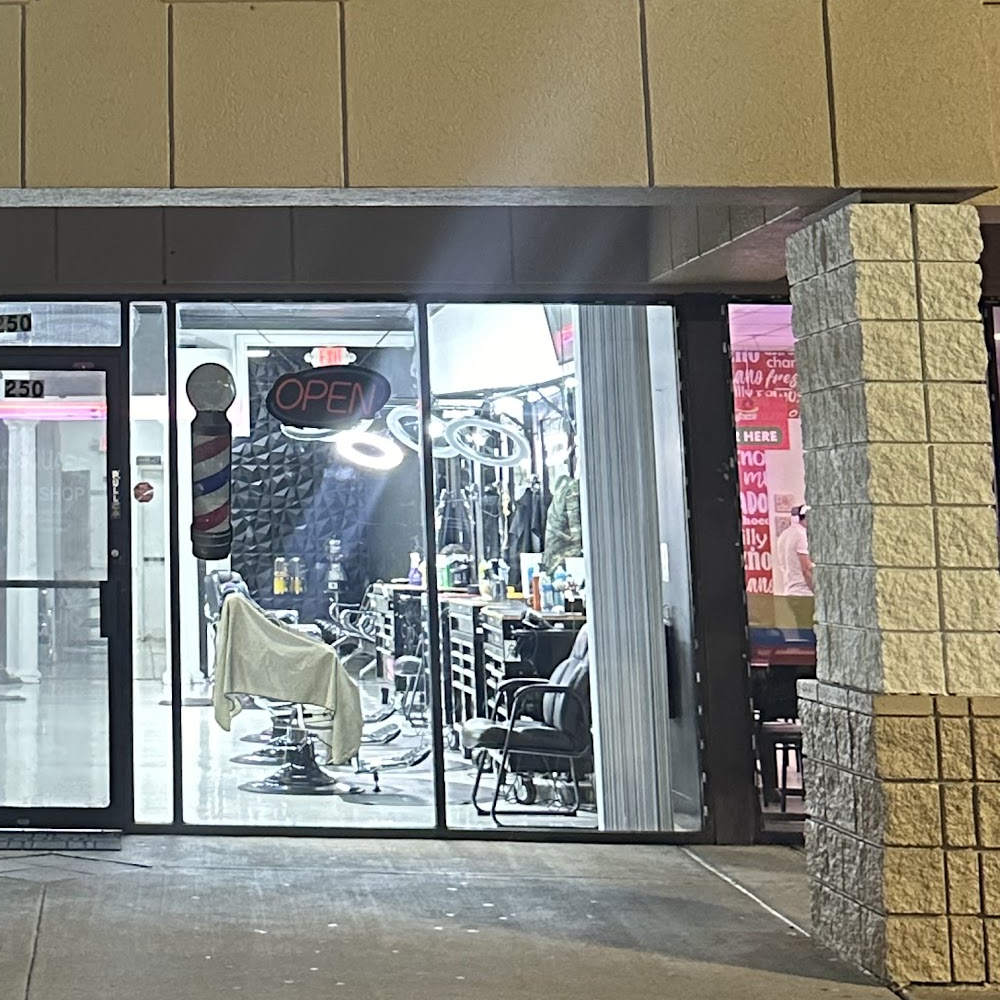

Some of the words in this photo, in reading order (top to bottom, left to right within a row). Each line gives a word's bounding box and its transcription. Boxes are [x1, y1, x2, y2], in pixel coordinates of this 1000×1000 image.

[6, 380, 44, 397] 250
[275, 378, 377, 415] OPEN
[743, 430, 778, 442] HERE
